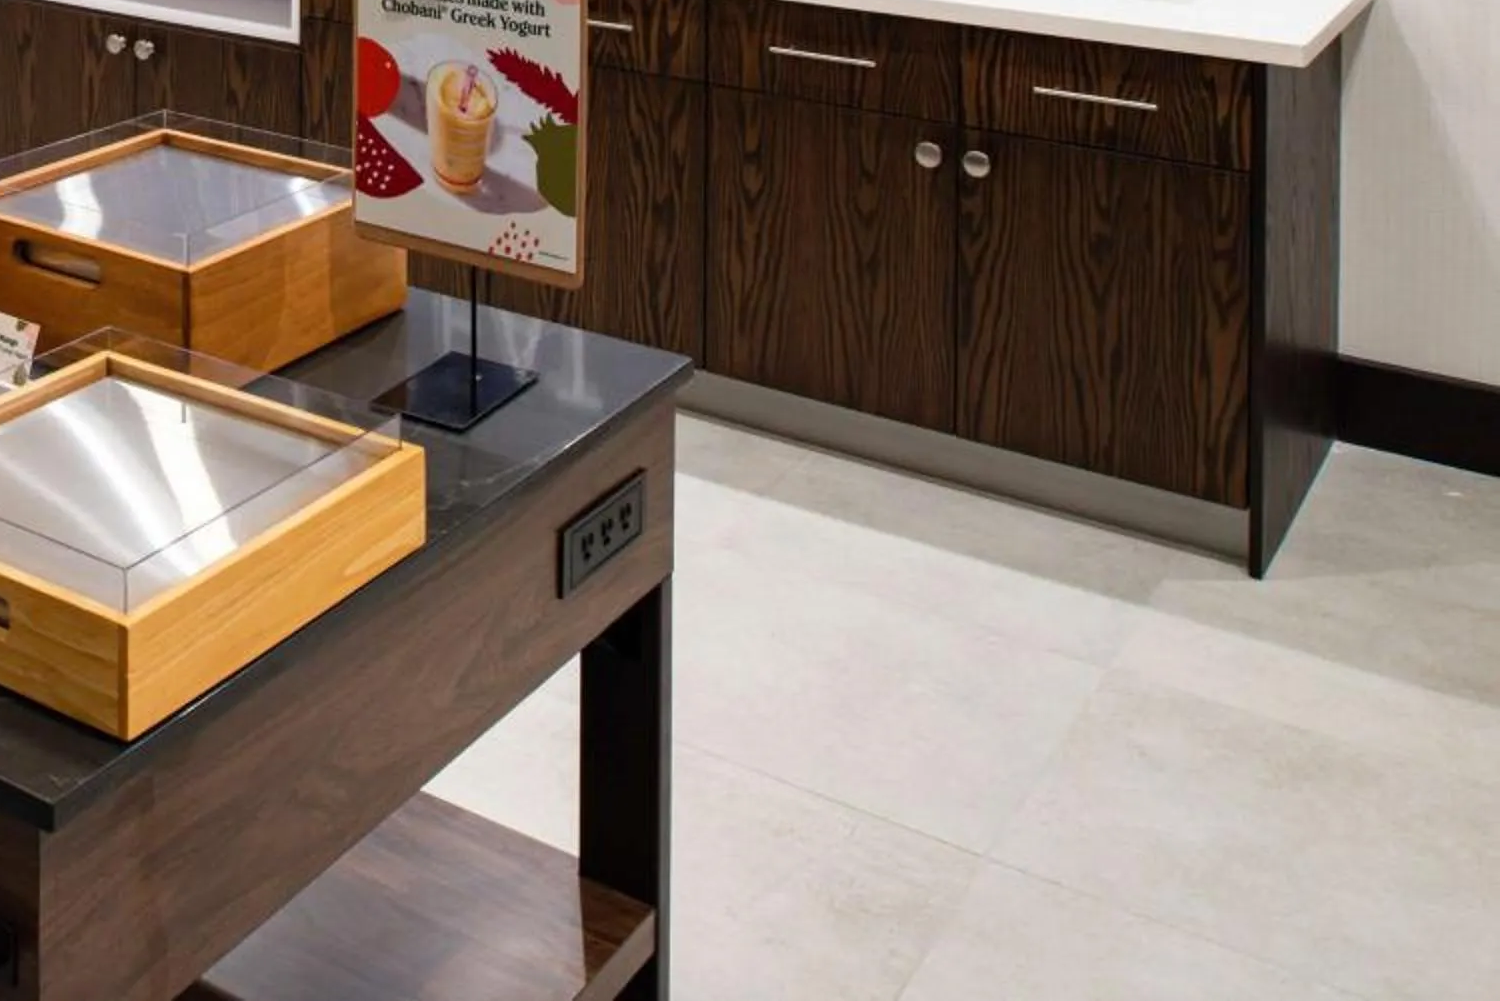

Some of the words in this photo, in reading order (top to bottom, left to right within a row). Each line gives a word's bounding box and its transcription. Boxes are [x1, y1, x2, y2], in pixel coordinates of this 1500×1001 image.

[512, 0, 546, 18] with
[450, 8, 496, 29] Greek
[500, 15, 552, 39] Yogurt
